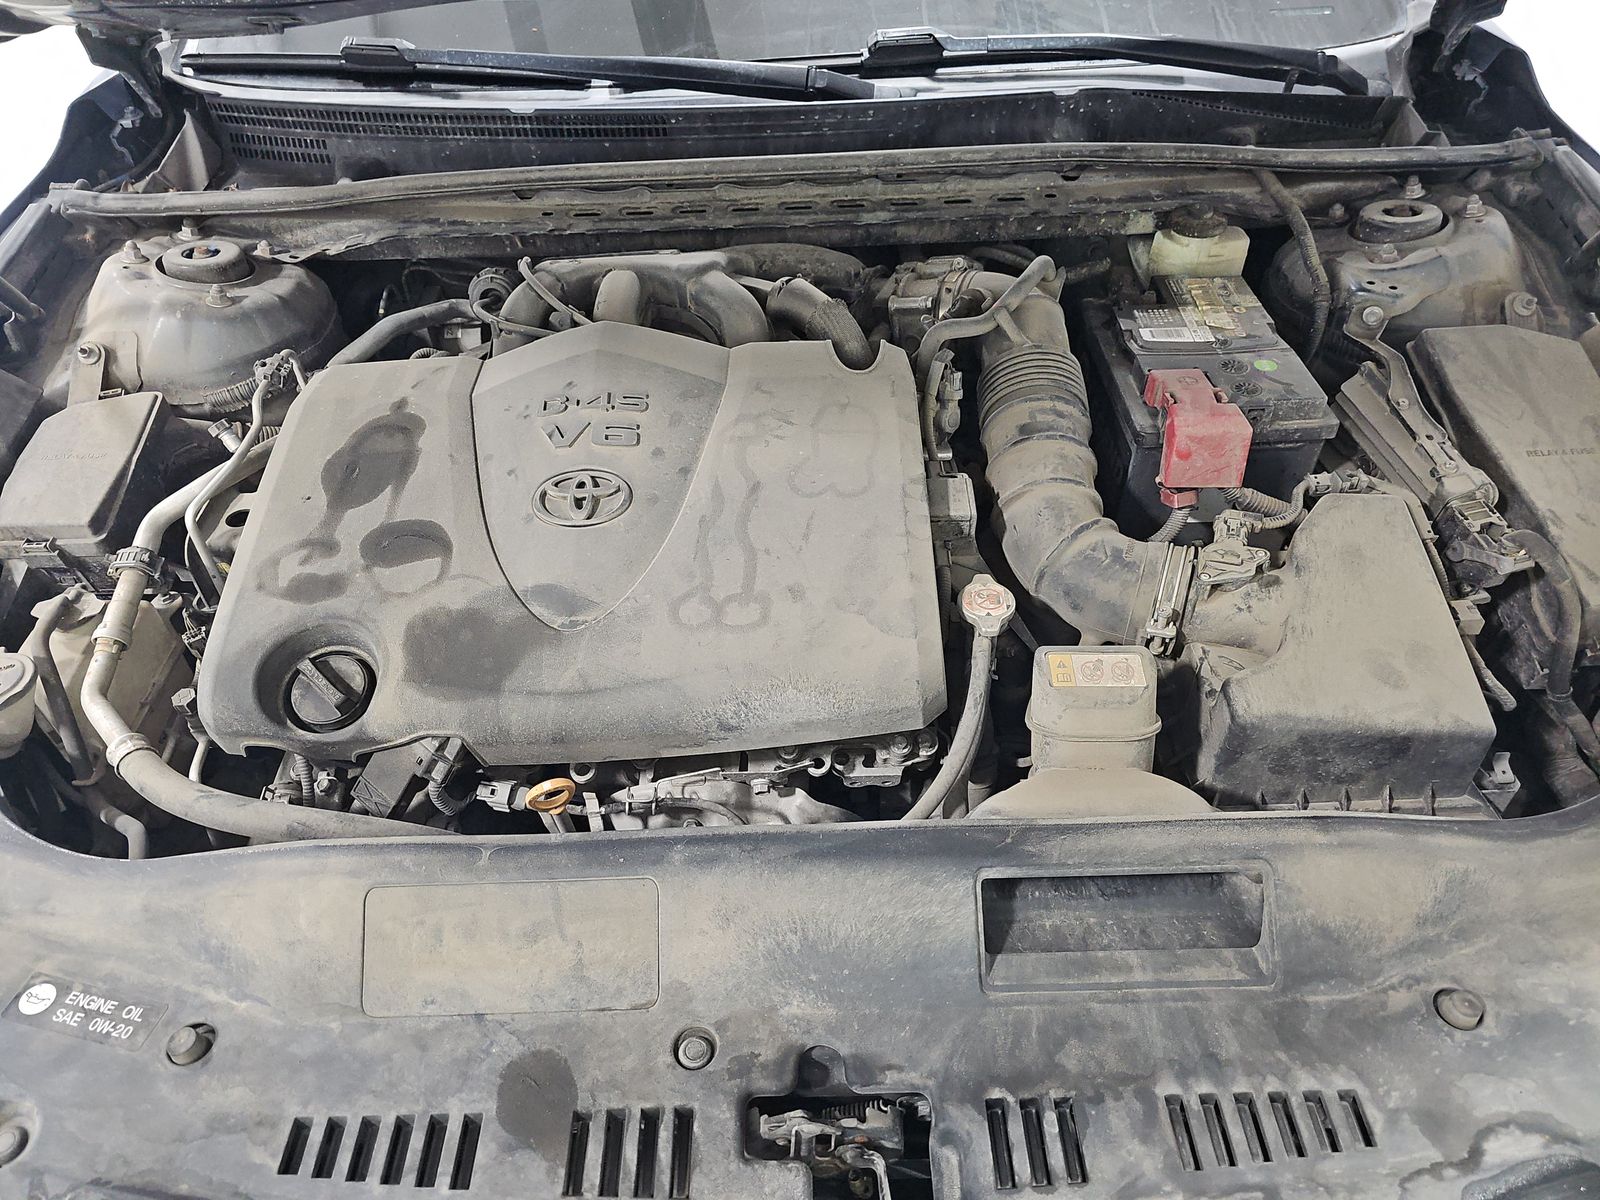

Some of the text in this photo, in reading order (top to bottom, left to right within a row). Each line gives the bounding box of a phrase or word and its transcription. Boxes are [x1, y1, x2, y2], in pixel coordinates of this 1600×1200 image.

[540, 420, 641, 448] V6
[1525, 448, 1559, 458] RELAY
[64, 991, 145, 1022] ENGINE OIL
[52, 1008, 134, 1039] SAE 0W-20
